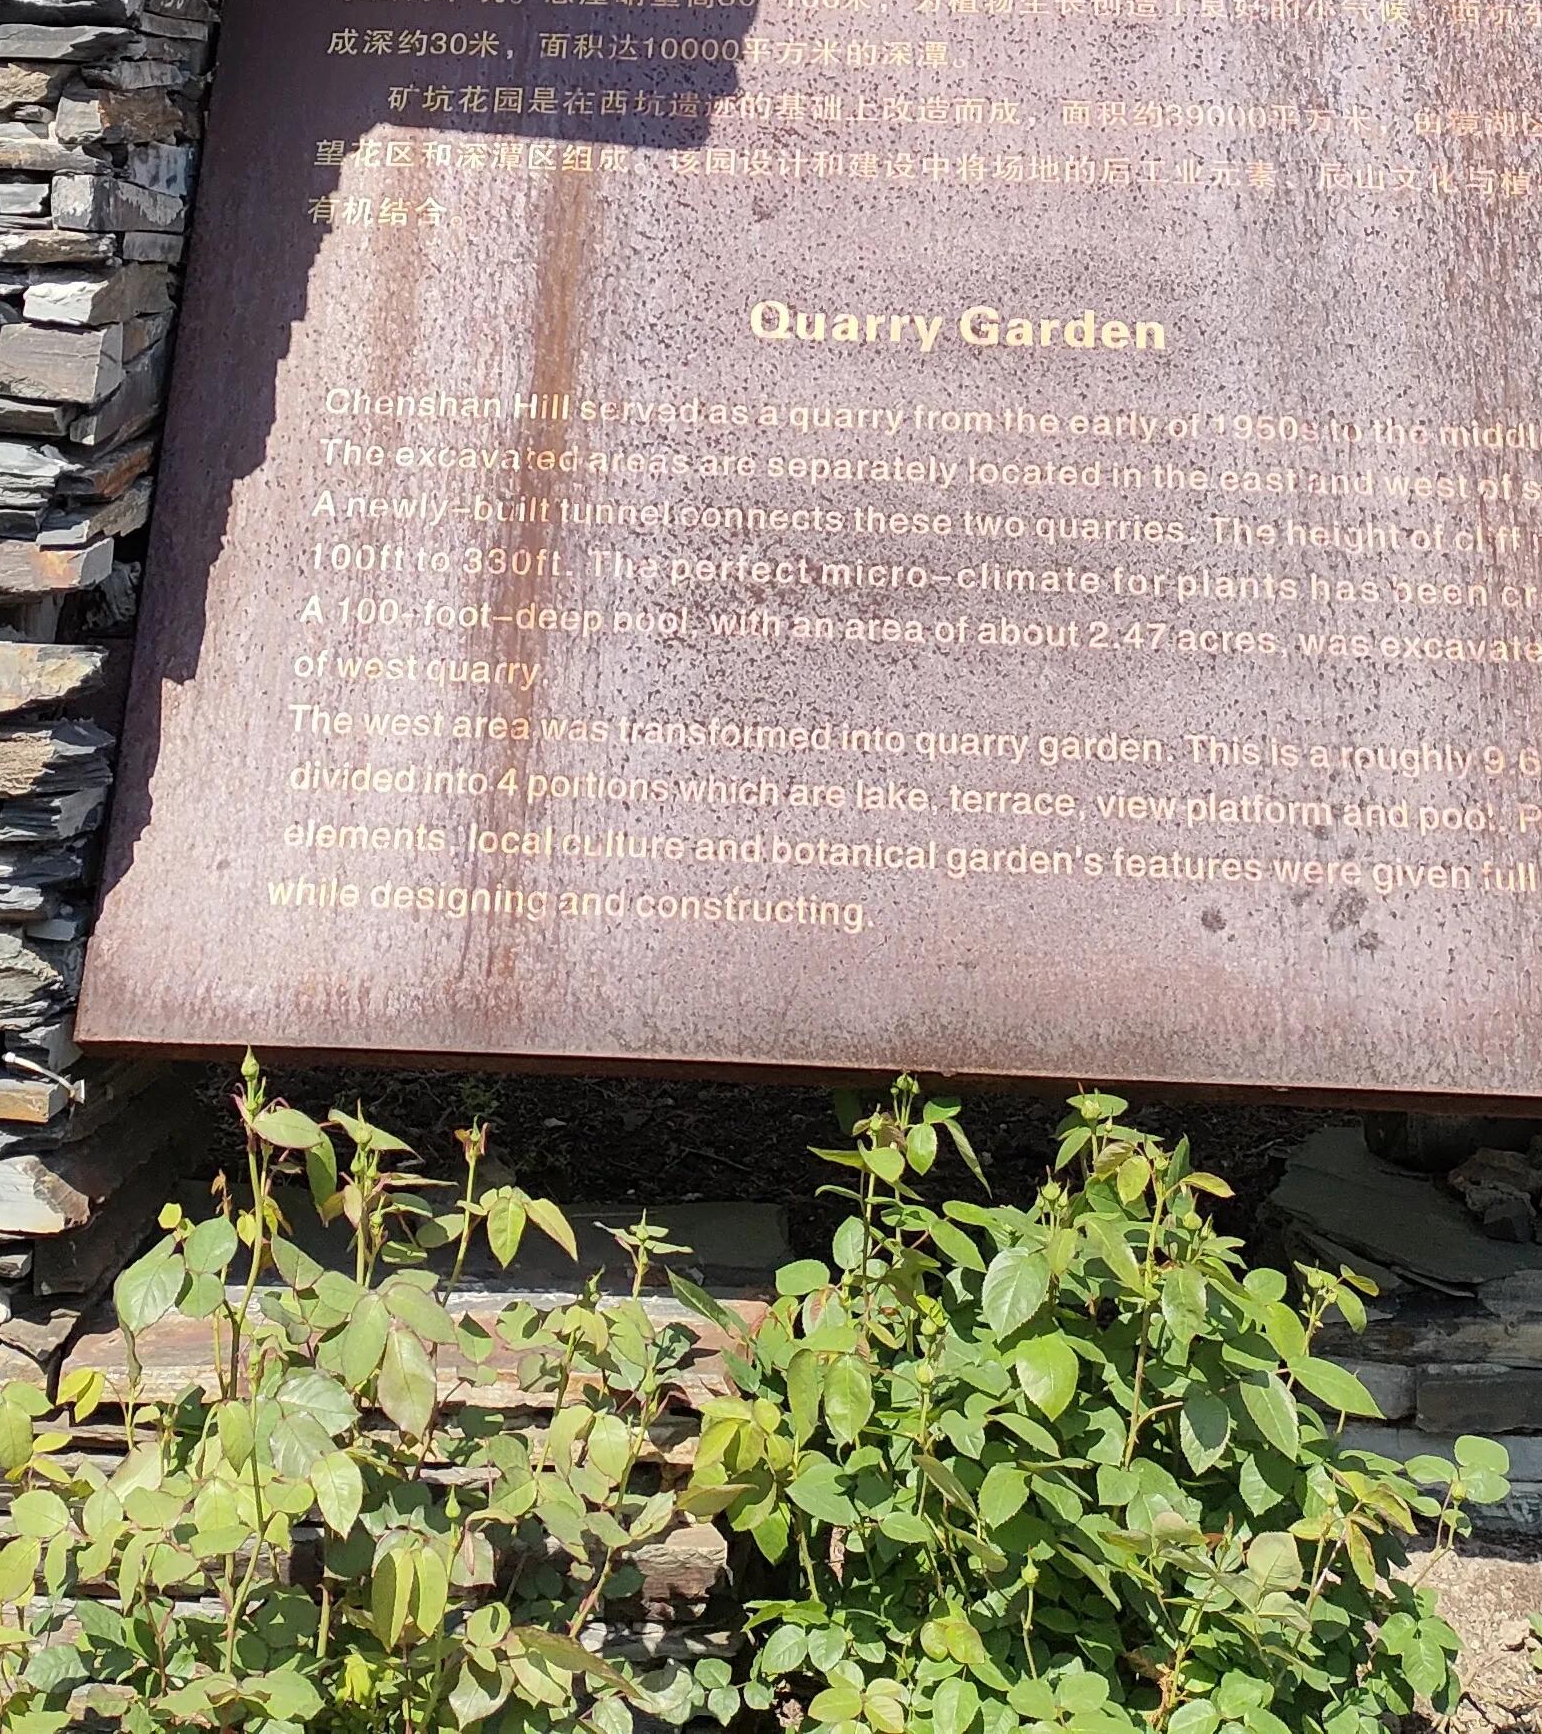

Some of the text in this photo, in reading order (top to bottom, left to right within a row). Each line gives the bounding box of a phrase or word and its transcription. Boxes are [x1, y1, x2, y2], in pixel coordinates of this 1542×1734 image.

[750, 299, 1167, 352] Quarry Garden
[324, 387, 502, 418] Chenshan
[513, 392, 570, 421] Hill
[580, 396, 699, 424] served
[708, 403, 749, 426] as
[759, 405, 779, 427] a
[789, 406, 904, 434] quarry
[913, 404, 993, 433] from
[1004, 408, 1059, 435] the
[1070, 412, 1158, 443] early
[1168, 412, 1200, 438] of
[1212, 413, 1318, 444] 1950s
[1330, 419, 1363, 444] to
[1374, 420, 1429, 446] the
[320, 437, 386, 467] The
[395, 443, 579, 472] excavated
[588, 452, 689, 474] areas
[699, 454, 756, 475] are
[767, 454, 958, 488] separately
[969, 461, 1101, 488] located
[1112, 461, 1142, 488] in
[1152, 462, 1209, 490] the
[1220, 469, 1297, 493] east
[1307, 469, 1374, 497] and
[1384, 473, 1469, 499] west
[1478, 473, 1512, 501] of
[311, 489, 337, 517] A
[346, 493, 550, 526] newly-built
[560, 498, 670, 526] tunnel
[680, 504, 845, 534] connects
[854, 505, 952, 535] these
[963, 509, 1026, 538] two
[1035, 514, 1196, 544] quarries.
[1208, 515, 1276, 546] The
[1286, 521, 1400, 555] height
[1410, 524, 1444, 552] of
[1455, 523, 1521, 555] cliff
[313, 542, 405, 572] 100ft
[417, 547, 450, 572] to
[463, 547, 573, 577] 330ft.
[588, 551, 659, 580] The
[670, 553, 809, 585] perfect
[820, 560, 1100, 593] micro-climate
[1113, 566, 1166, 595] for
[1177, 568, 1297, 600] plants
[1310, 572, 1380, 603] has
[1392, 576, 1488, 606] been
[298, 595, 324, 625] A
[336, 597, 602, 636] 100-foot-deep
[710, 609, 781, 638] with
[791, 614, 835, 639] an
[844, 619, 925, 644] area
[934, 616, 968, 645] of
[977, 616, 1079, 647] about
[1088, 620, 1167, 651] 2.47
[1177, 626, 1288, 657] acres,
[1298, 633, 1370, 659] was
[294, 649, 550, 692] of west quarry.
[288, 704, 353, 736] The
[362, 709, 444, 737] west
[452, 715, 530, 741] area
[540, 717, 609, 743] was
[619, 713, 832, 751] transformed
[841, 723, 906, 754] into
[916, 729, 1029, 760] quarry
[1039, 731, 1175, 766] garden.
[1182, 734, 1261, 766] This
[1270, 736, 1299, 767] is
[1309, 745, 1330, 769] a
[1340, 742, 1473, 779] roughly
[1482, 746, 1541, 777] 9.6
[289, 763, 415, 795] divided
[424, 768, 489, 796] into
[496, 768, 518, 797] 4
[527, 769, 669, 801] portions
[678, 774, 780, 807] which
[790, 786, 846, 809] are
[856, 779, 939, 816] lake,
[949, 785, 1087, 820] terrace,
[1097, 790, 1178, 821] view
[1186, 790, 1333, 828] platform
[1342, 799, 1409, 830] and
[1418, 803, 1507, 836] pool.
[283, 818, 458, 858] elements,
[469, 823, 551, 857] local
[561, 825, 684, 861] culture
[694, 831, 761, 863] and
[772, 835, 937, 871] botanical
[946, 841, 1103, 879] garden's
[1113, 844, 1264, 882] features
[1273, 858, 1362, 886] were
[1372, 858, 1471, 895] given
[1482, 860, 1536, 893] full
[267, 877, 874, 933] while designing and constructing.
